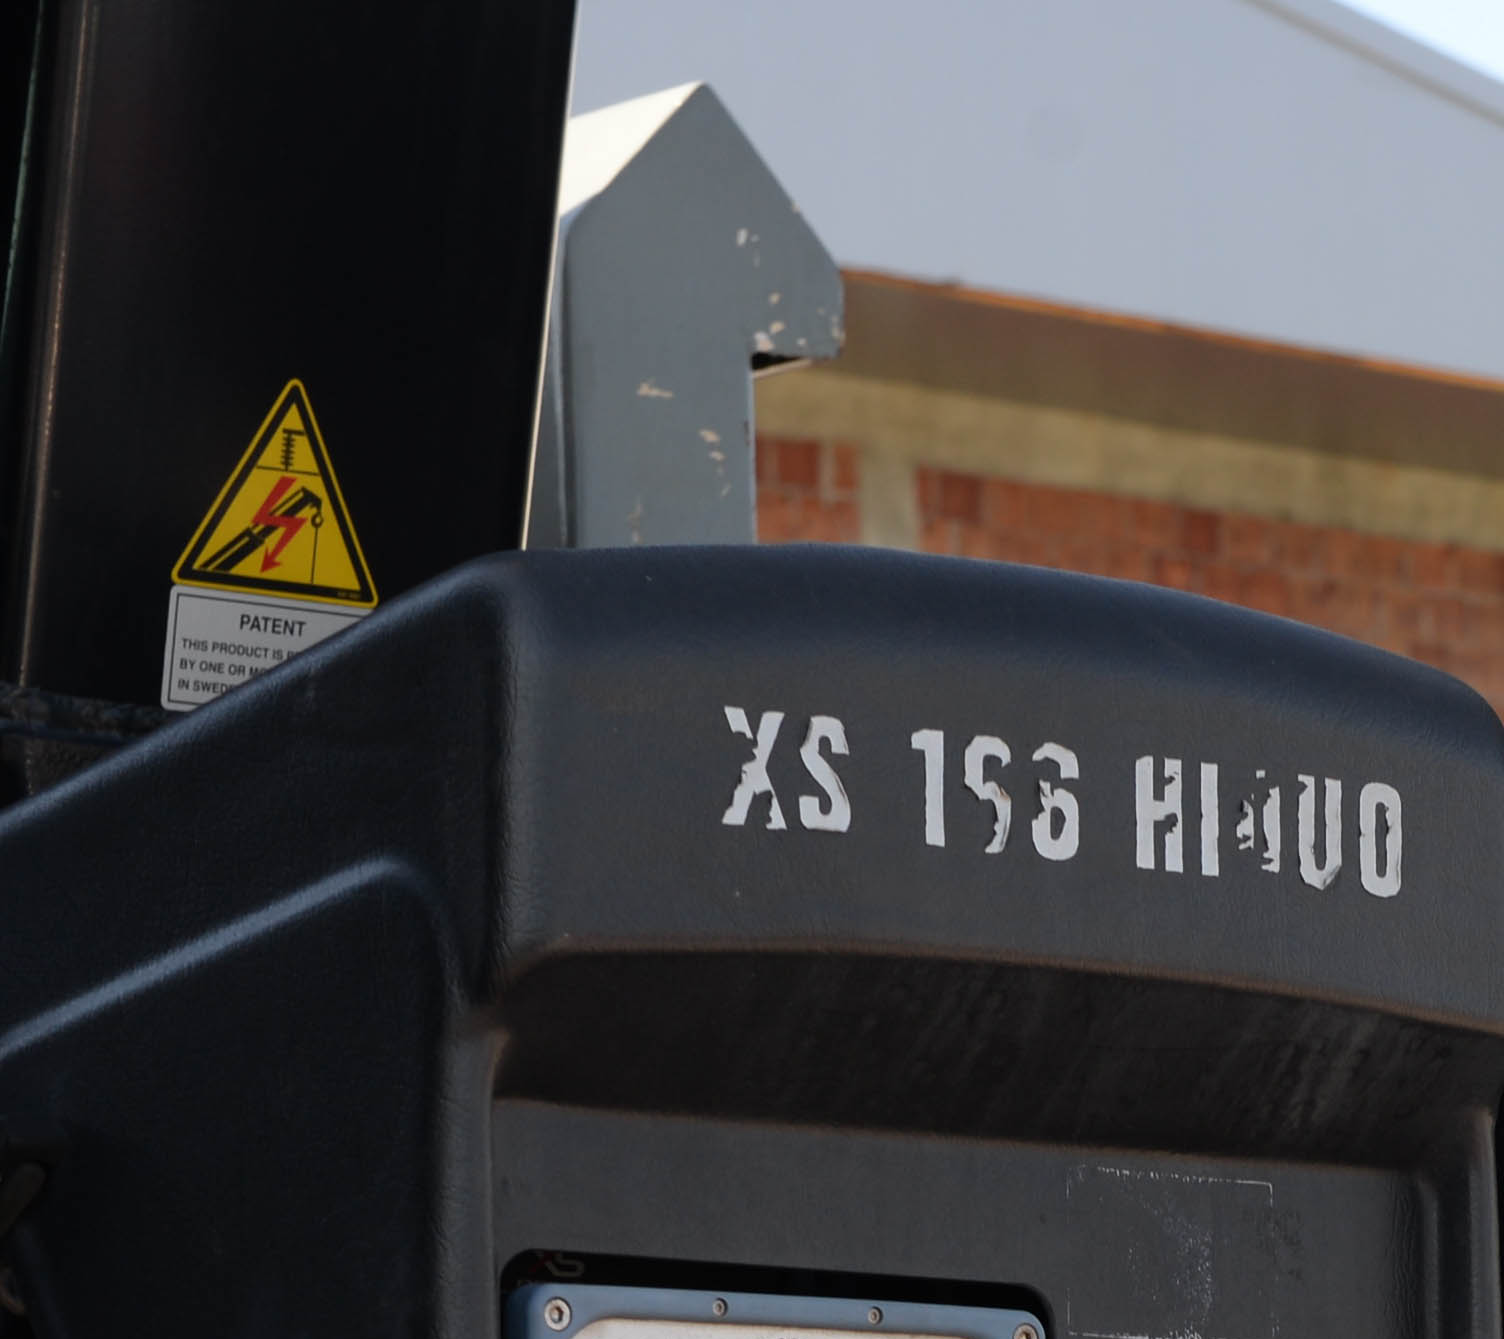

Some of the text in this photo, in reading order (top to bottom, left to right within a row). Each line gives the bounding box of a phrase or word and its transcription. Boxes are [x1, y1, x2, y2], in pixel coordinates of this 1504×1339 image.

[239, 613, 307, 638] PATENT
[181, 637, 209, 652] THIS
[211, 641, 270, 660] PRODUCT
[272, 648, 284, 661] IS
[179, 657, 196, 671] BY
[199, 660, 225, 674] ONE
[228, 663, 246, 677] OR
[177, 678, 235, 695] IN SWED
[722, 705, 852, 833] XS
